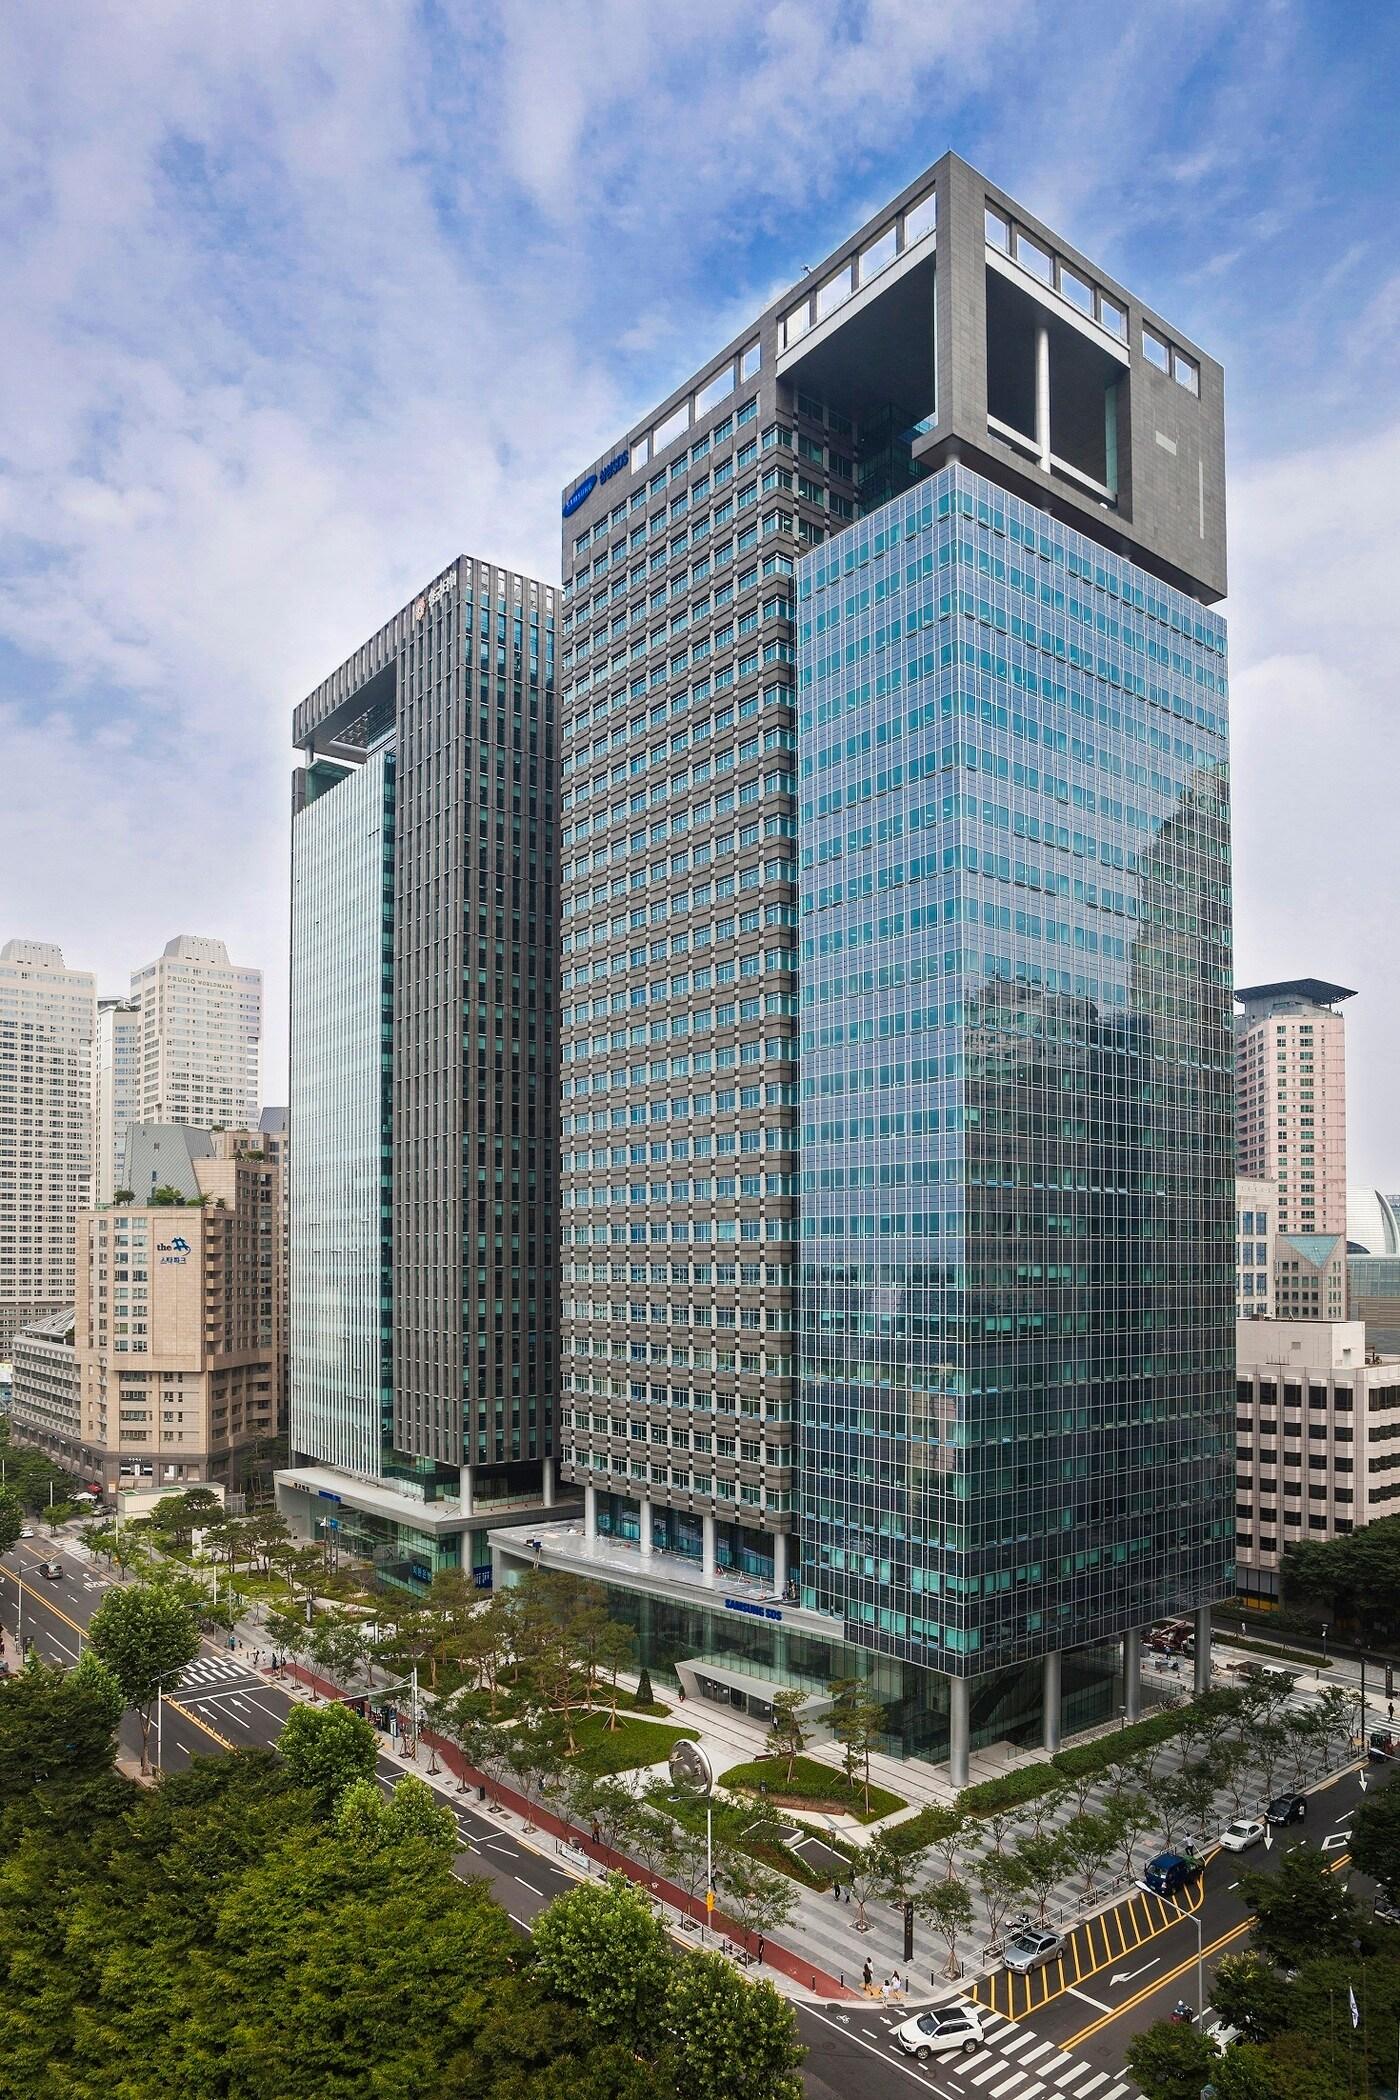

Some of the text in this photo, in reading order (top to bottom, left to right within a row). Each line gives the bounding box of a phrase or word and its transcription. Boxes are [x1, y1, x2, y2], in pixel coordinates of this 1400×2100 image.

[167, 976, 233, 989] PRUGIO WORLDMARK
[157, 1243, 172, 1251] the
[724, 1598, 782, 1621] SAMSUNG SDS
